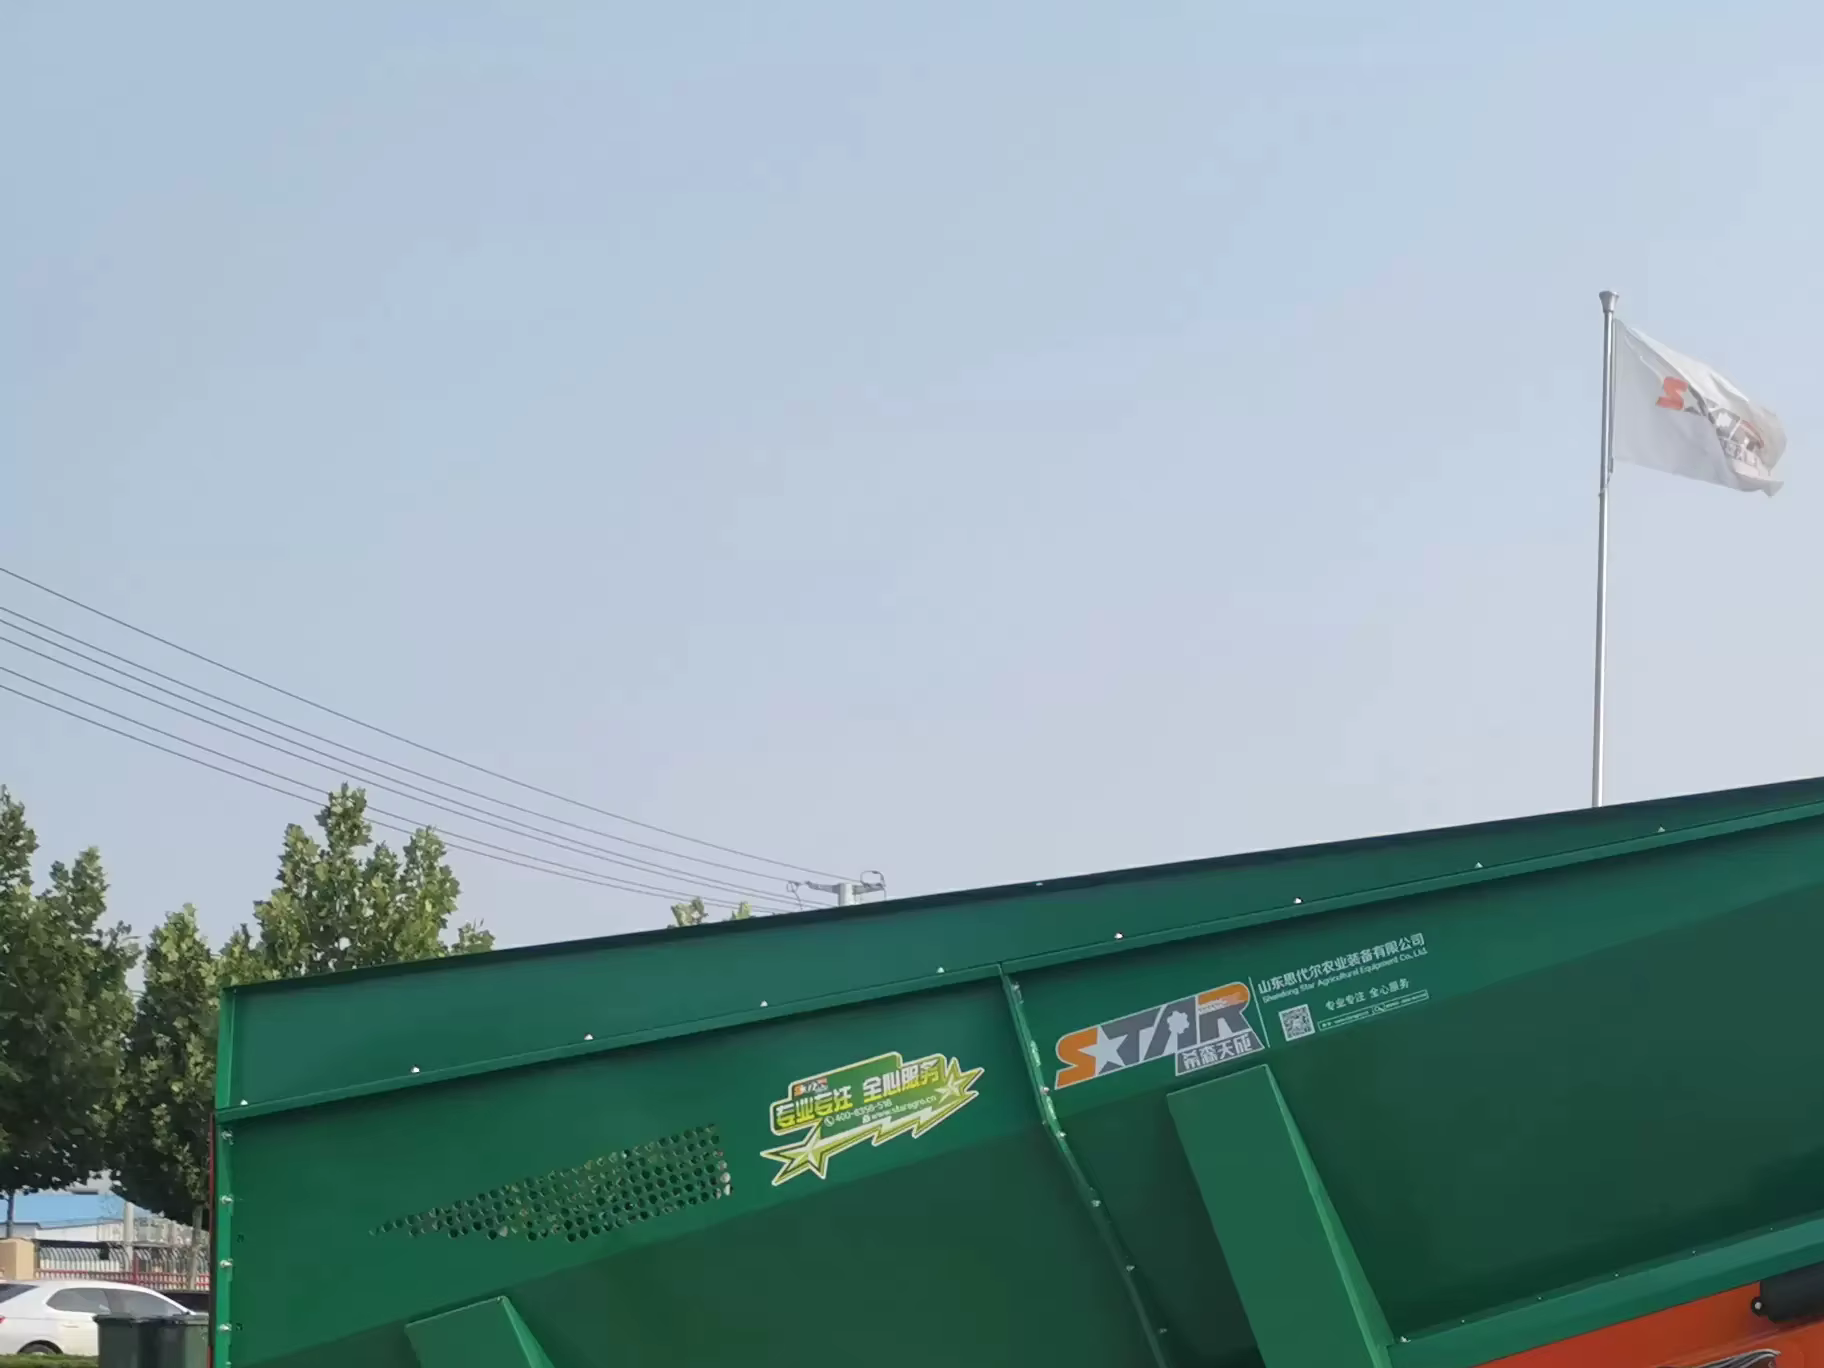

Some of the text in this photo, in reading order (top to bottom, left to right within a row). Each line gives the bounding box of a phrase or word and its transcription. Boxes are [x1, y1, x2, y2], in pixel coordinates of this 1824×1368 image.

[1258, 932, 1425, 994] 山东思代尔农业装备有限公司
[1317, 968, 1360, 988] Agricultural
[1360, 956, 1399, 974] Equipment
[775, 1058, 941, 1128] 专业专注 全心服务
